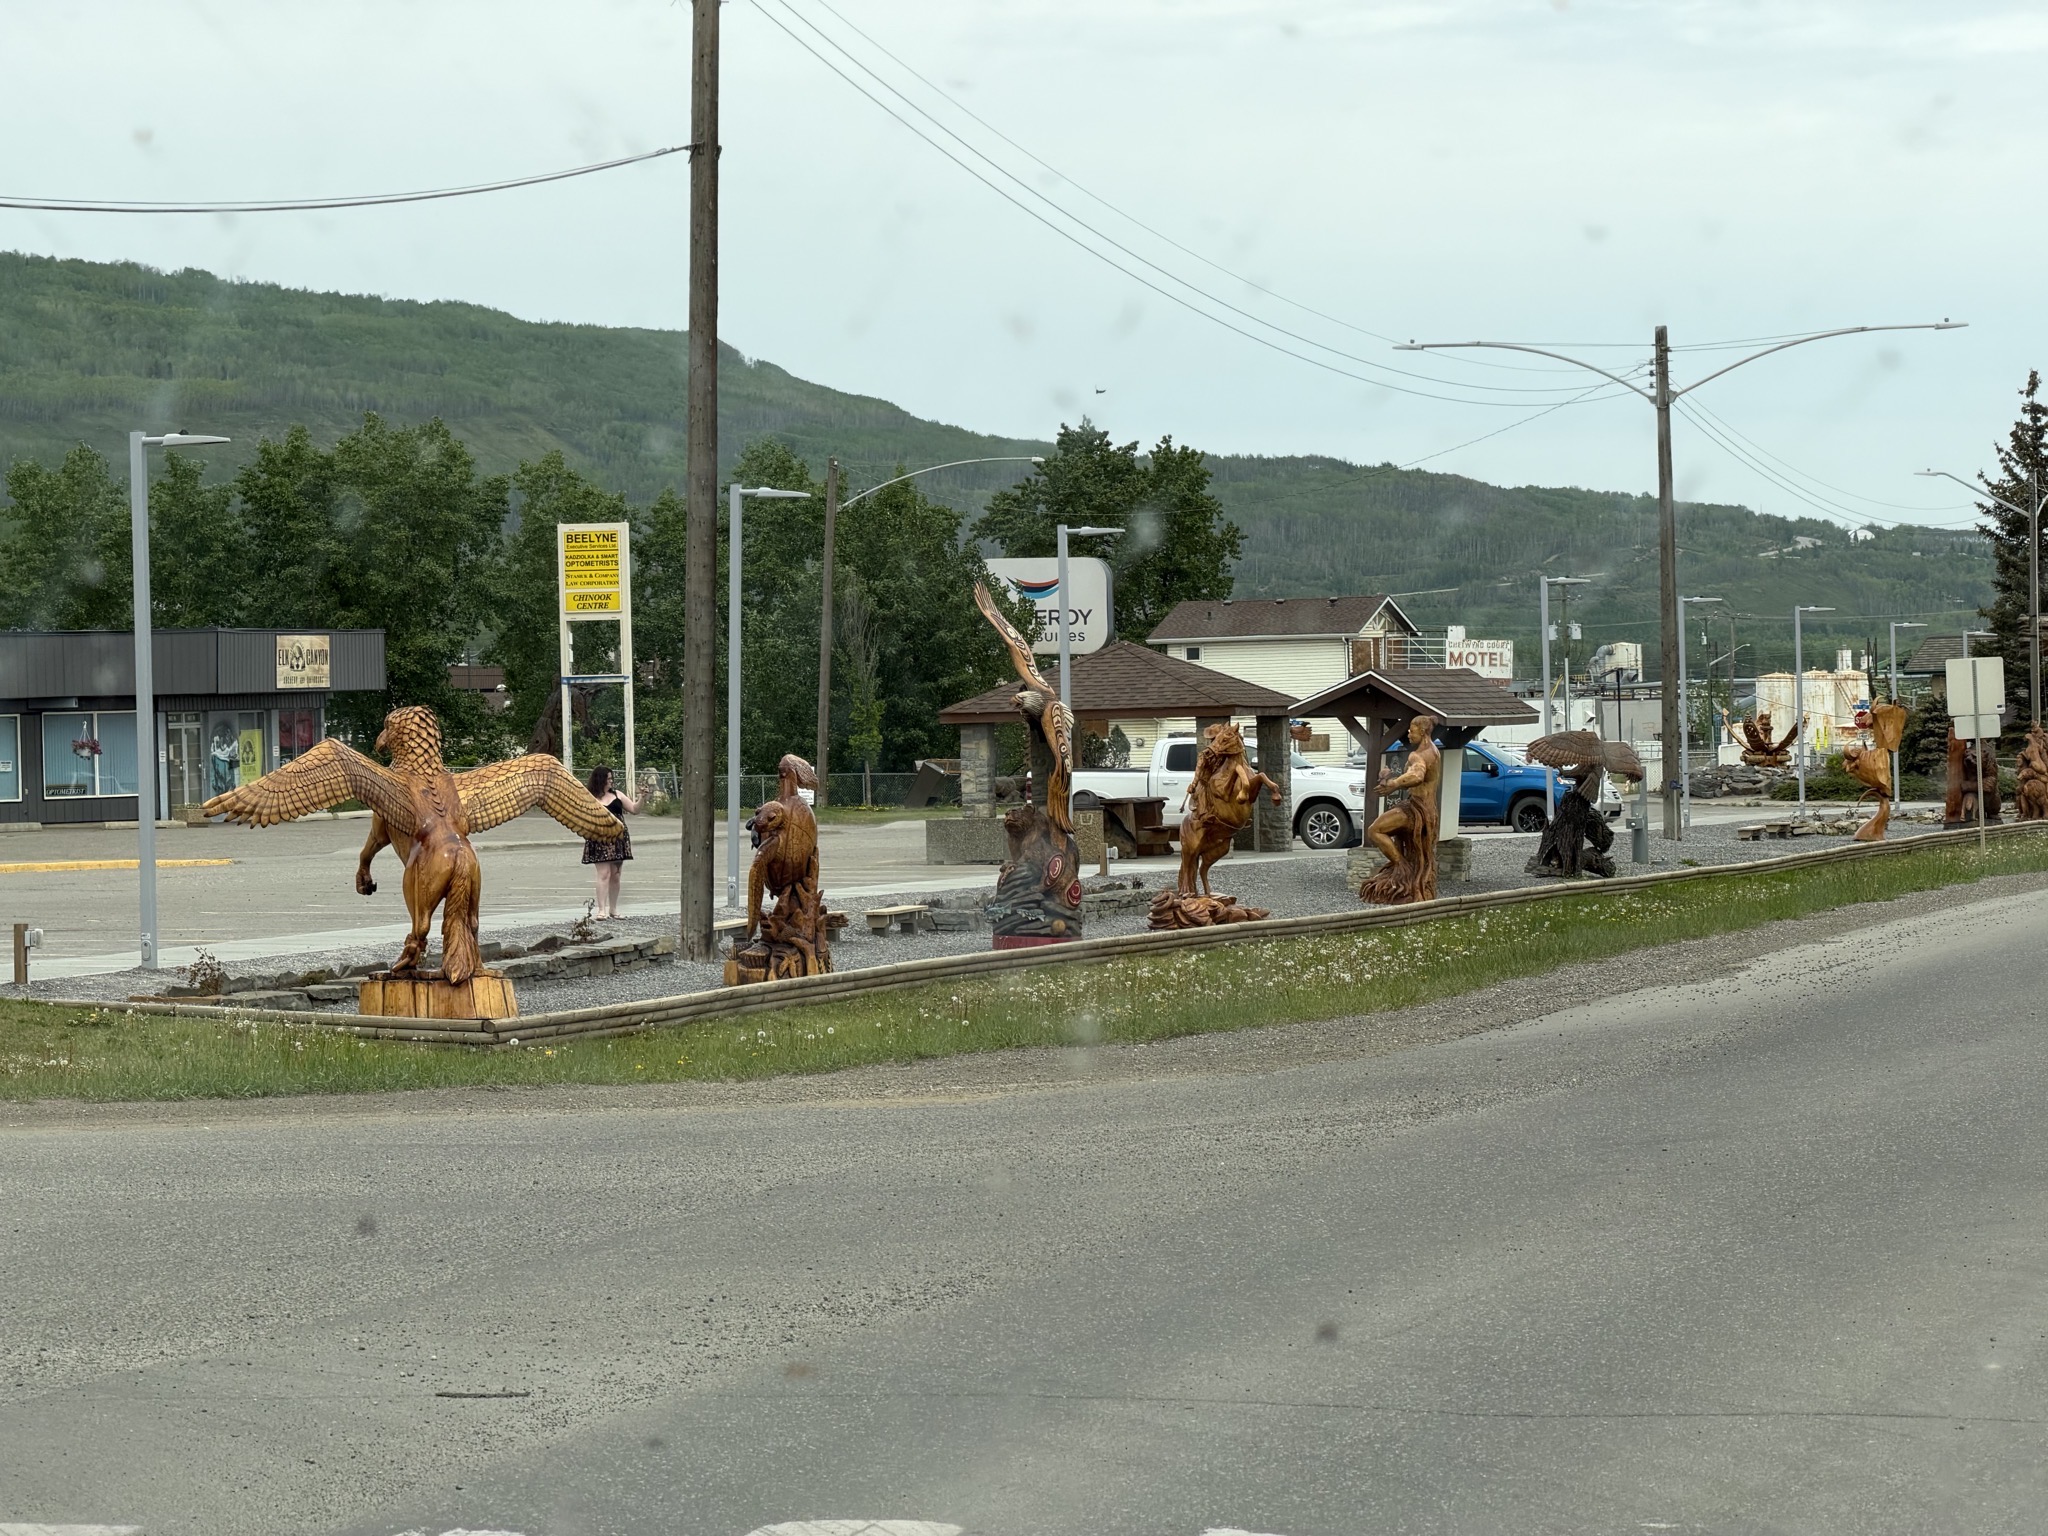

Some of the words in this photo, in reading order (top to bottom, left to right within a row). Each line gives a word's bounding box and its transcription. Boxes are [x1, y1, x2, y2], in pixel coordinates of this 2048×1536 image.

[566, 533, 617, 543] BEELYNE
[572, 593, 612, 602] CHINOOK
[576, 602, 609, 610] CENTRE
[305, 649, 329, 665] CANYON
[1449, 651, 1509, 668] MOTEL
